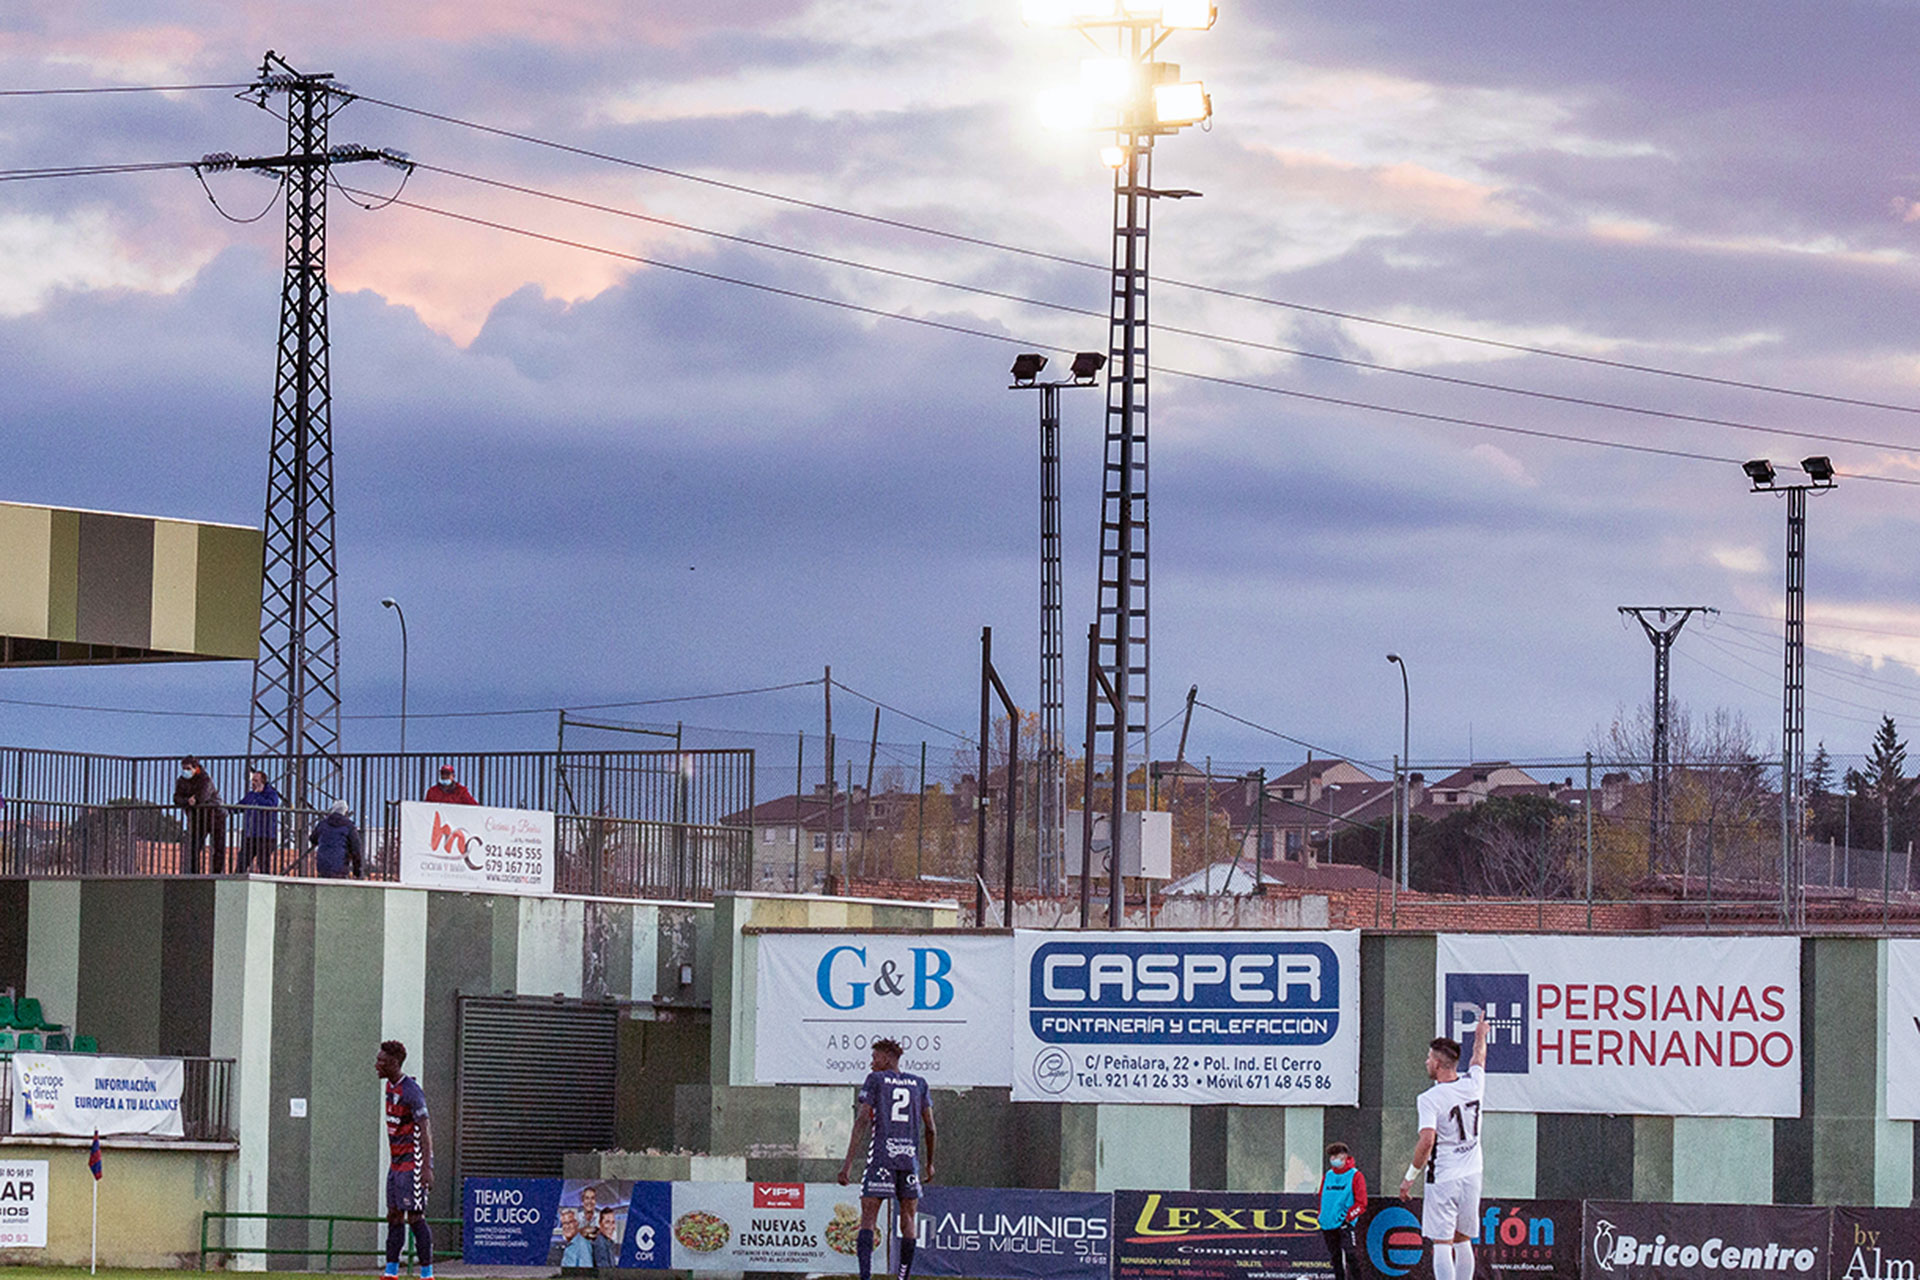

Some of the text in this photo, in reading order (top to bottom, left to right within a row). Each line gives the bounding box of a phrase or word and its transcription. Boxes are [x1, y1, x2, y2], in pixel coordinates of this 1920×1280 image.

[485, 845, 543, 860] 921 445 555
[485, 860, 543, 875] 679 167 710
[816, 945, 955, 1011] G&B
[1043, 954, 1321, 1003] CASPER
[1537, 984, 1786, 1022] PERSIANAS
[1042, 1017, 1165, 1034] FONTANERÍA
[1188, 1017, 1328, 1034] CALEFACCIÓN
[1537, 1029, 1794, 1068] HERNANDO
[1085, 1054, 1322, 1071] C/ Peñalara, 22 Pol. Ind. El Cerro
[33, 1075, 64, 1089] europe
[94, 1077, 157, 1092] INFORMACIÓN
[1077, 1073, 1332, 1089] Tel. 921 41 26 33 Móvil 671 48 45 86
[33, 1087, 58, 1101] direct
[75, 1096, 116, 1110] EUROPEA
[118, 1098, 124, 1110] A
[126, 1098, 137, 1110] TU
[891, 1087, 910, 1122] 2
[1449, 1100, 1480, 1141] 17
[474, 1190, 523, 1206] TIEMPO
[0, 1207, 29, 1216] IOS
[474, 1207, 540, 1224] DE JUEGO
[1134, 1194, 1321, 1236] LEXUS
[752, 1219, 807, 1233] NUEVAS
[937, 1212, 1108, 1240] ALUMINIOS
[740, 1233, 818, 1248] ENSALADAS
[936, 1234, 1108, 1257] LUIS MIGUEL S.L.
[1854, 1223, 1881, 1252] by
[635, 1251, 654, 1261] COPE
[1178, 1245, 1288, 1256] Computers
[1614, 1235, 1815, 1272] BricoCentro
[1842, 1246, 1920, 1280] Alm
